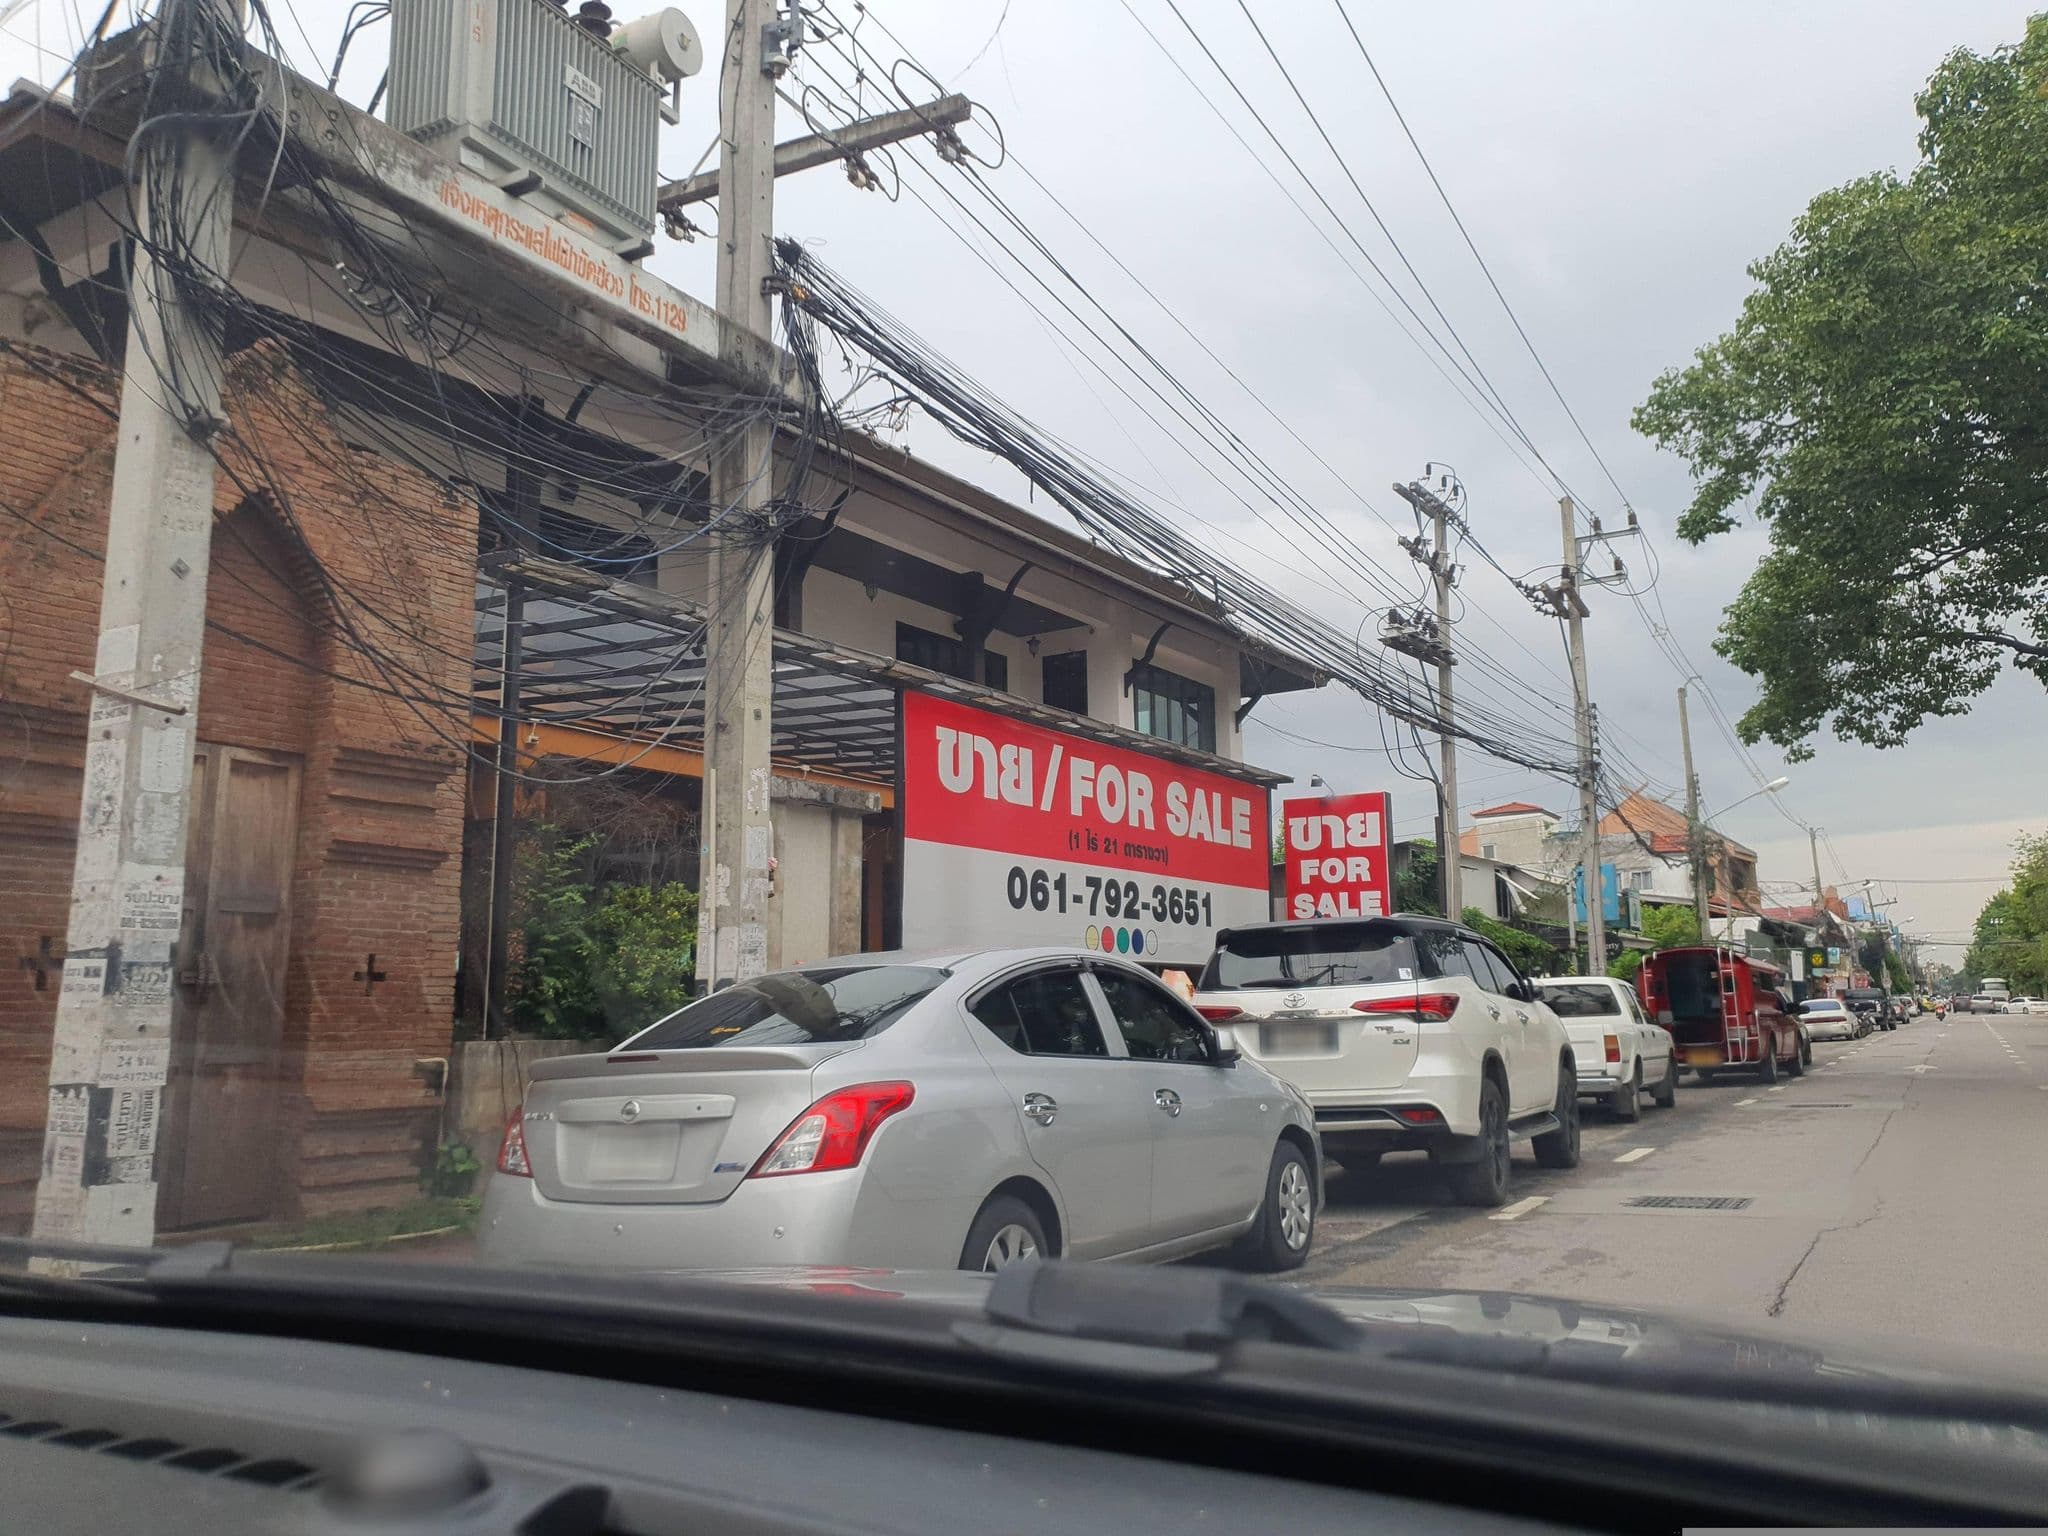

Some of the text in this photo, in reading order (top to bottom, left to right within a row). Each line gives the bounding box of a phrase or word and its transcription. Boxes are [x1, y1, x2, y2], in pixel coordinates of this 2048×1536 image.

[628, 272, 688, 333] โทร.1129
[936, 725, 1034, 808] ขาย
[1070, 756, 1155, 831] FOR
[1166, 781, 1252, 850] SALE
[1103, 836, 1118, 856] 21
[1288, 811, 1381, 851] ขาย
[1300, 856, 1372, 885] FOR
[1007, 865, 1212, 928] 061-792-3651
[1293, 890, 1383, 919] SALE
